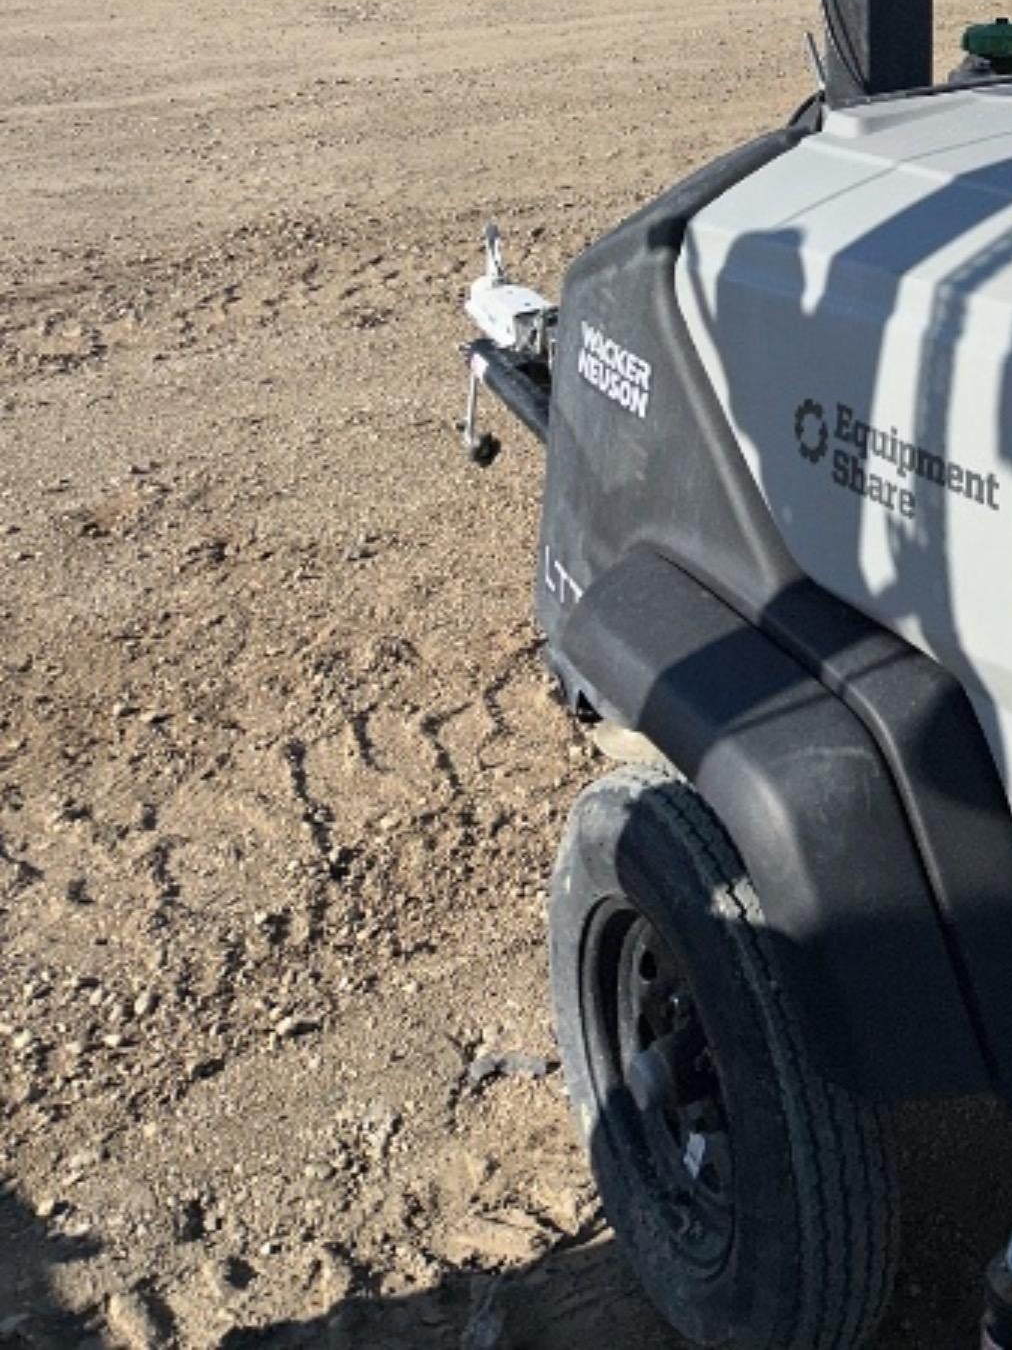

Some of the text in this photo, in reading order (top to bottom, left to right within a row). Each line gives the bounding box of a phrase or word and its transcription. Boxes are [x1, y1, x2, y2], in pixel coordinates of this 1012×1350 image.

[577, 350, 649, 418] NEUSON
[580, 319, 652, 390] WACKER
[831, 449, 916, 519] Share
[834, 402, 1000, 511] Equipment
